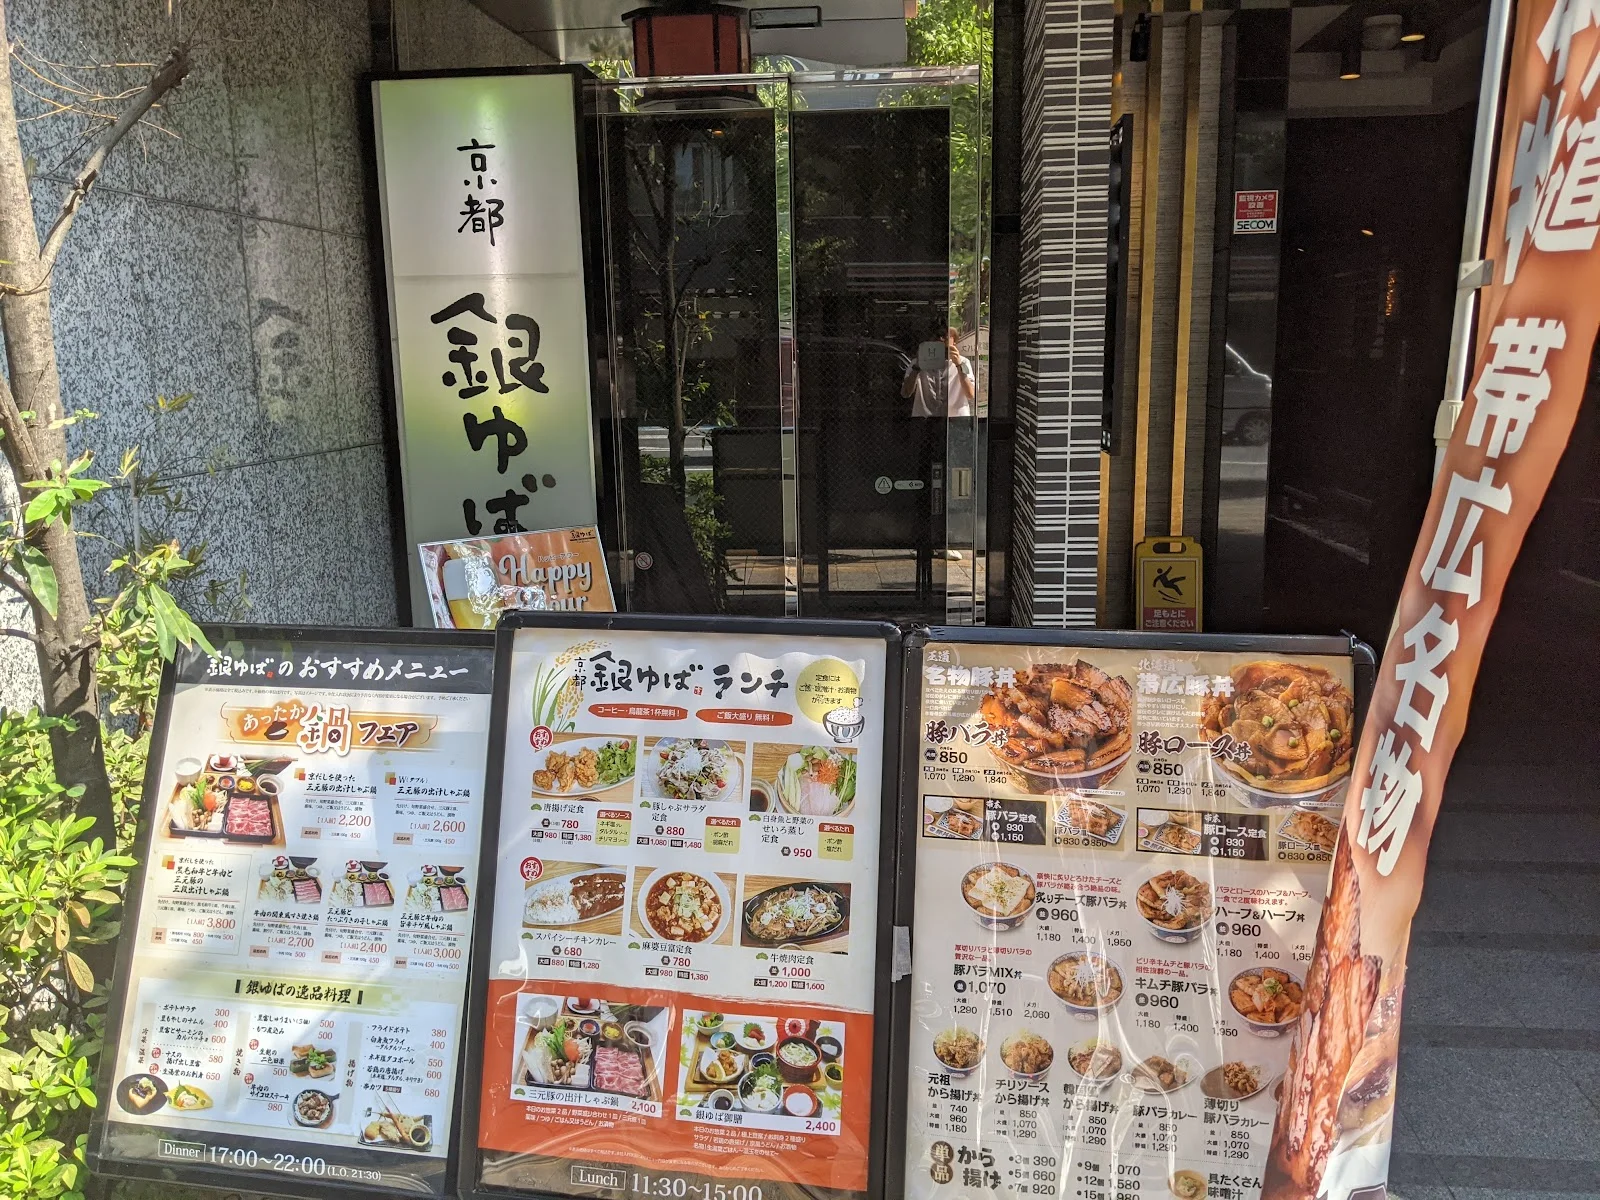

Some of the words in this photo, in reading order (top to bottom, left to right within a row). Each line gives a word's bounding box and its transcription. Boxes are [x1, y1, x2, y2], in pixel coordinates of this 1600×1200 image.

[456, 139, 505, 246] 京都
[1237, 220, 1274, 230] SECOM
[431, 293, 556, 535] 銀ゆば
[499, 554, 593, 594] Happy
[1154, 609, 1186, 618] 足もとに
[571, 656, 587, 691] 京都
[589, 650, 704, 692] 銀ゆば
[925, 664, 1018, 688] 名物豚丼
[712, 665, 789, 700] ランチ
[1136, 673, 1235, 698] 帯広豚丼
[924, 720, 1009, 748] 豚バラ丼
[1136, 730, 1252, 761] 豚ロース丼
[939, 750, 968, 764] 850
[1153, 763, 1184, 776] 850
[923, 772, 947, 781] 1,070
[952, 774, 976, 783] 1,290
[984, 775, 1007, 784] 1,840
[1136, 785, 1161, 793] 1,070
[1167, 786, 1192, 795] 1,290
[543, 803, 585, 814] 唐揚げ定食
[652, 801, 707, 814] 豚しゃぶサラダ
[338, 814, 372, 827] 2,200
[762, 814, 814, 825] 白身魚と野菜の
[985, 810, 1037, 824] 豚バラ定食
[433, 819, 466, 833] 2,600
[561, 819, 580, 830] 780
[762, 825, 805, 835] せいろ蒸し
[1006, 823, 1024, 832] 930
[666, 826, 685, 836] 880
[1203, 824, 1267, 839] 豚ロース定食
[761, 835, 779, 844] 定食
[1000, 833, 1024, 842] 1,150
[1226, 838, 1245, 847] 930
[793, 847, 813, 858] 950
[1219, 848, 1245, 857] 1,150
[1287, 852, 1305, 861] 630
[1035, 891, 1128, 910] 炙りチーズ豚バラ丼
[1051, 908, 1079, 922] 960
[1216, 907, 1306, 923] ハーフ&ハーフ丼
[206, 917, 236, 930] 3,800
[1231, 923, 1261, 937] 960
[288, 936, 315, 948] 2,700
[536, 932, 617, 946] スパイシーチキンカレー
[1036, 932, 1061, 942] 1,180
[1107, 938, 1132, 948] 1,950
[360, 941, 388, 954] 2,400
[433, 947, 462, 959] 3,000
[564, 946, 583, 957] 680
[1216, 947, 1243, 958] 1,180
[1254, 950, 1280, 960] 1,400
[673, 956, 691, 967] 780
[770, 952, 815, 966] 牛焼肉定食
[582, 961, 600, 970] 1,280
[953, 963, 1023, 980] 豚バラMIX丼
[690, 972, 709, 981] 1,380
[782, 966, 811, 978] 1,000
[768, 979, 788, 988] 1,200
[806, 981, 825, 991] 1,600
[968, 980, 1006, 995] 1,070
[1135, 977, 1218, 997] キムチ豚バラ丼
[246, 979, 353, 1004] 銀ゆばの逸品料理
[1149, 994, 1179, 1009] 960
[215, 1008, 230, 1017] 300
[953, 1005, 978, 1015] 1,290
[1023, 1009, 1050, 1019] 2,060
[213, 1019, 229, 1029] 400
[1135, 1019, 1161, 1029] 1,180
[1173, 1022, 1199, 1033] 1,400
[431, 1028, 447, 1038] 380
[430, 1040, 446, 1050] 400
[427, 1058, 443, 1068] 550
[206, 1071, 221, 1081] 650
[272, 1068, 288, 1077] 500
[426, 1071, 442, 1080] 600
[927, 1072, 951, 1086] 元祖
[995, 1079, 1050, 1093] チリソース
[424, 1088, 440, 1098] 680
[927, 1086, 981, 1102] から揚げ丼
[994, 1093, 1050, 1108] から揚げ丼
[1203, 1097, 1240, 1112] 薄切り
[267, 1102, 283, 1112] 980
[631, 1100, 657, 1114] 2,100
[950, 1104, 968, 1114] 740
[1132, 1104, 1198, 1120] 豚バラカレー
[1019, 1109, 1037, 1119] 850
[1088, 1115, 1107, 1125] 850
[1203, 1111, 1270, 1128] 豚バラカレー
[805, 1119, 836, 1132] 2,400
[944, 1123, 968, 1133] 1,180
[1012, 1119, 1037, 1129] 1,070
[1012, 1129, 1037, 1139] 1,290
[1081, 1126, 1107, 1136] 1,070
[1230, 1130, 1250, 1140] 850
[1081, 1135, 1107, 1146] 1,290
[1223, 1140, 1250, 1150] 1,070
[164, 1142, 201, 1159] Dinner
[1223, 1150, 1249, 1159] 1,290
[957, 1146, 996, 1168] から
[1033, 1156, 1056, 1167] 390
[579, 1168, 619, 1187] Lunch
[962, 1168, 1002, 1190] 揚げ
[1032, 1170, 1056, 1181] 660
[1208, 1173, 1262, 1189] 具たくさん
[1032, 1184, 1056, 1195] 920
